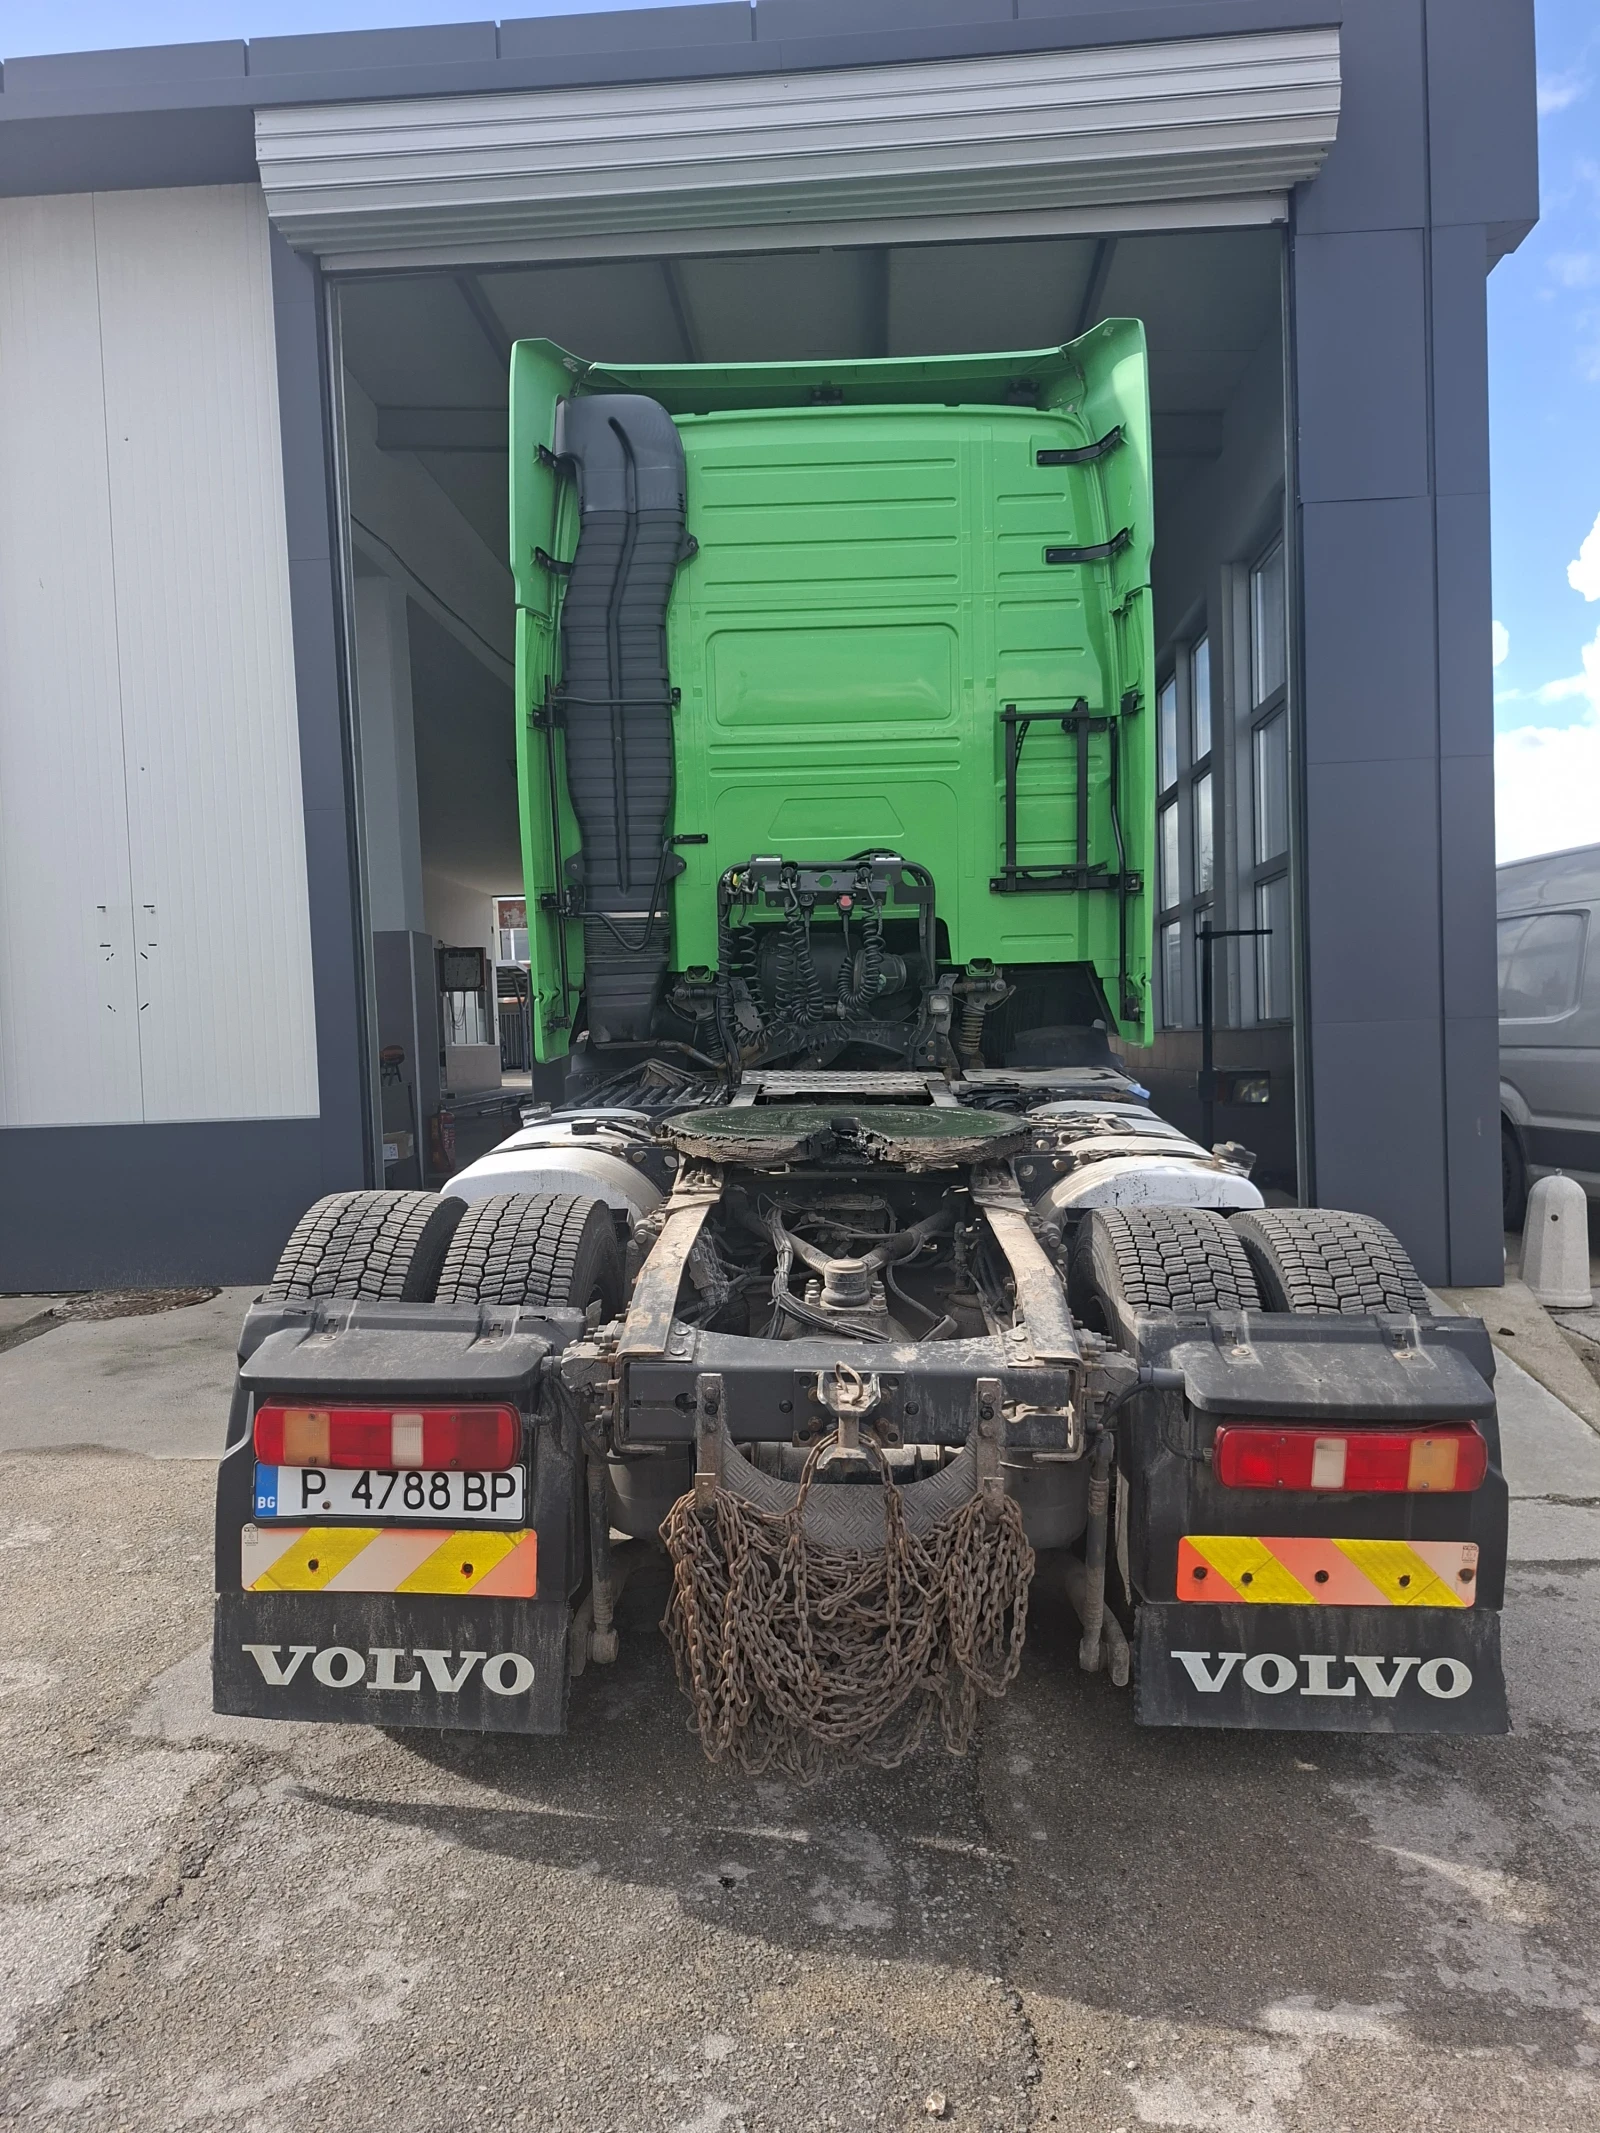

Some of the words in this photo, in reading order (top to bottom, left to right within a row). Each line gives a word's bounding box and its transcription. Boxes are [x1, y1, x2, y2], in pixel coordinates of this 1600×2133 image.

[257, 1496, 276, 1509] BG
[301, 1469, 326, 1509] P
[351, 1470, 450, 1510] 4788
[463, 1471, 516, 1512] BP
[241, 1643, 536, 1696] VOLVO
[1170, 1650, 1473, 1699] VOLVO
